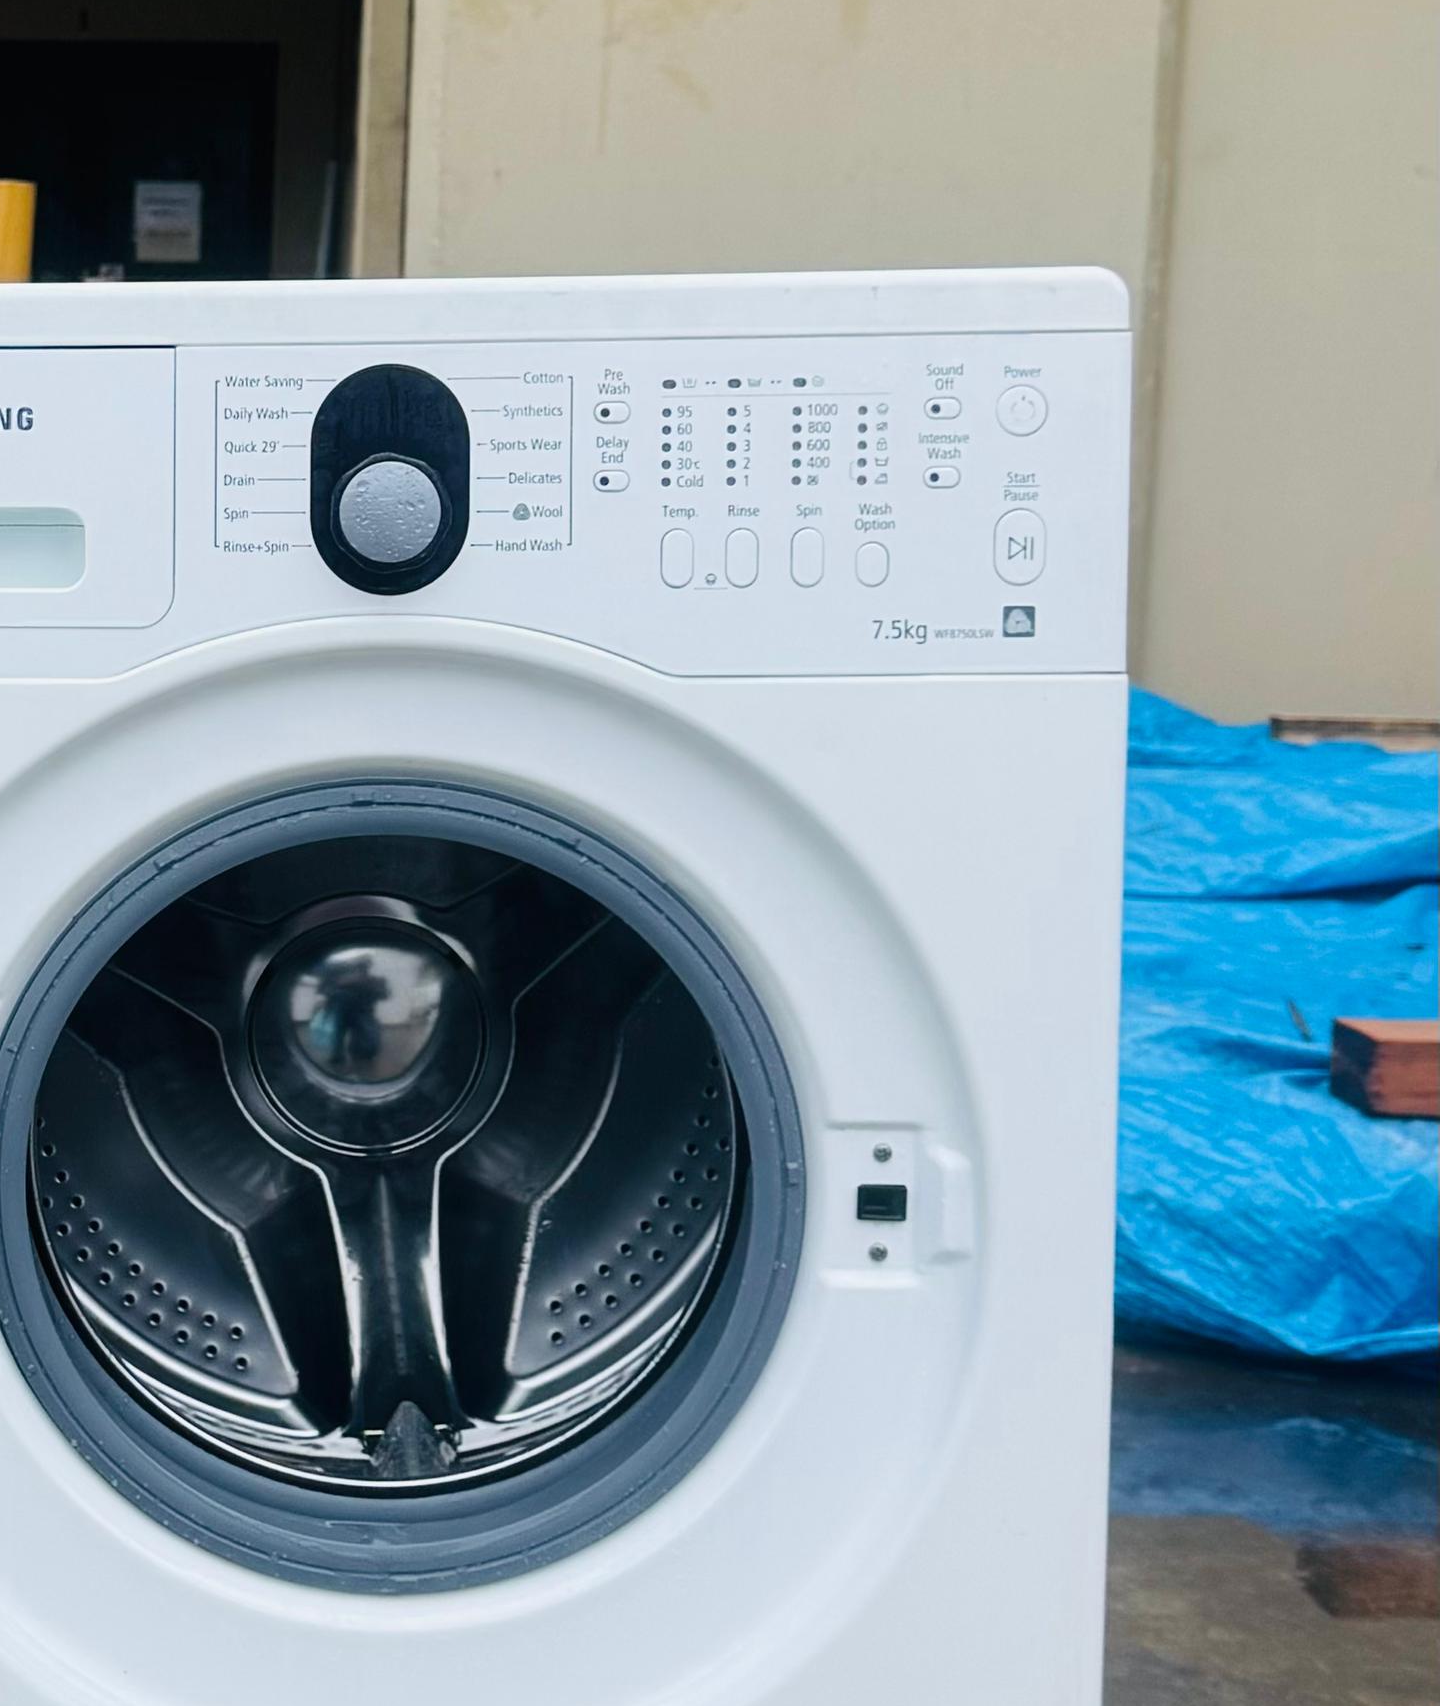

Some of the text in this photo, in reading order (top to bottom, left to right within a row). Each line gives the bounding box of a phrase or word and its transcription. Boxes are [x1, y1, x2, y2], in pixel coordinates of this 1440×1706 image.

[604, 369, 623, 381] Pre
[926, 364, 964, 376] Sound
[1004, 366, 1041, 378] Power
[225, 375, 303, 390] Water Saving
[523, 371, 564, 384] Cotton
[935, 378, 954, 390] Off
[597, 382, 631, 395] Wash
[224, 407, 288, 423] Daily Wash
[503, 404, 563, 419] Synthetics
[677, 405, 693, 418] 95
[743, 405, 751, 417] 5
[807, 403, 838, 416] 1000
[676, 423, 693, 435] 60
[743, 422, 751, 434] 4
[807, 421, 831, 434] 800
[596, 436, 629, 451] Delay
[806, 438, 830, 451] 600
[918, 432, 970, 444] Intensive
[224, 441, 257, 453] Quick
[490, 438, 562, 453] Sports Wear
[676, 440, 693, 452] 40
[743, 440, 751, 452] 3
[601, 451, 624, 463] End
[927, 447, 962, 459] Wash
[743, 457, 751, 469] 2
[806, 456, 830, 468] 400
[224, 474, 255, 486] Drain
[509, 472, 562, 484] Delicates
[676, 475, 704, 488] Cold
[1006, 471, 1036, 483] Start
[1003, 490, 1039, 501] Pause
[224, 508, 249, 521] Spin
[531, 505, 563, 518] Wool
[662, 505, 699, 519] Temp.
[727, 504, 760, 517] Rinse
[796, 504, 822, 518] Spin
[858, 503, 892, 516] Wash
[854, 518, 895, 532] Option
[223, 540, 289, 555] Rinse+Spin
[495, 539, 562, 551] Hand Wash
[872, 619, 927, 644] 7.5kg
